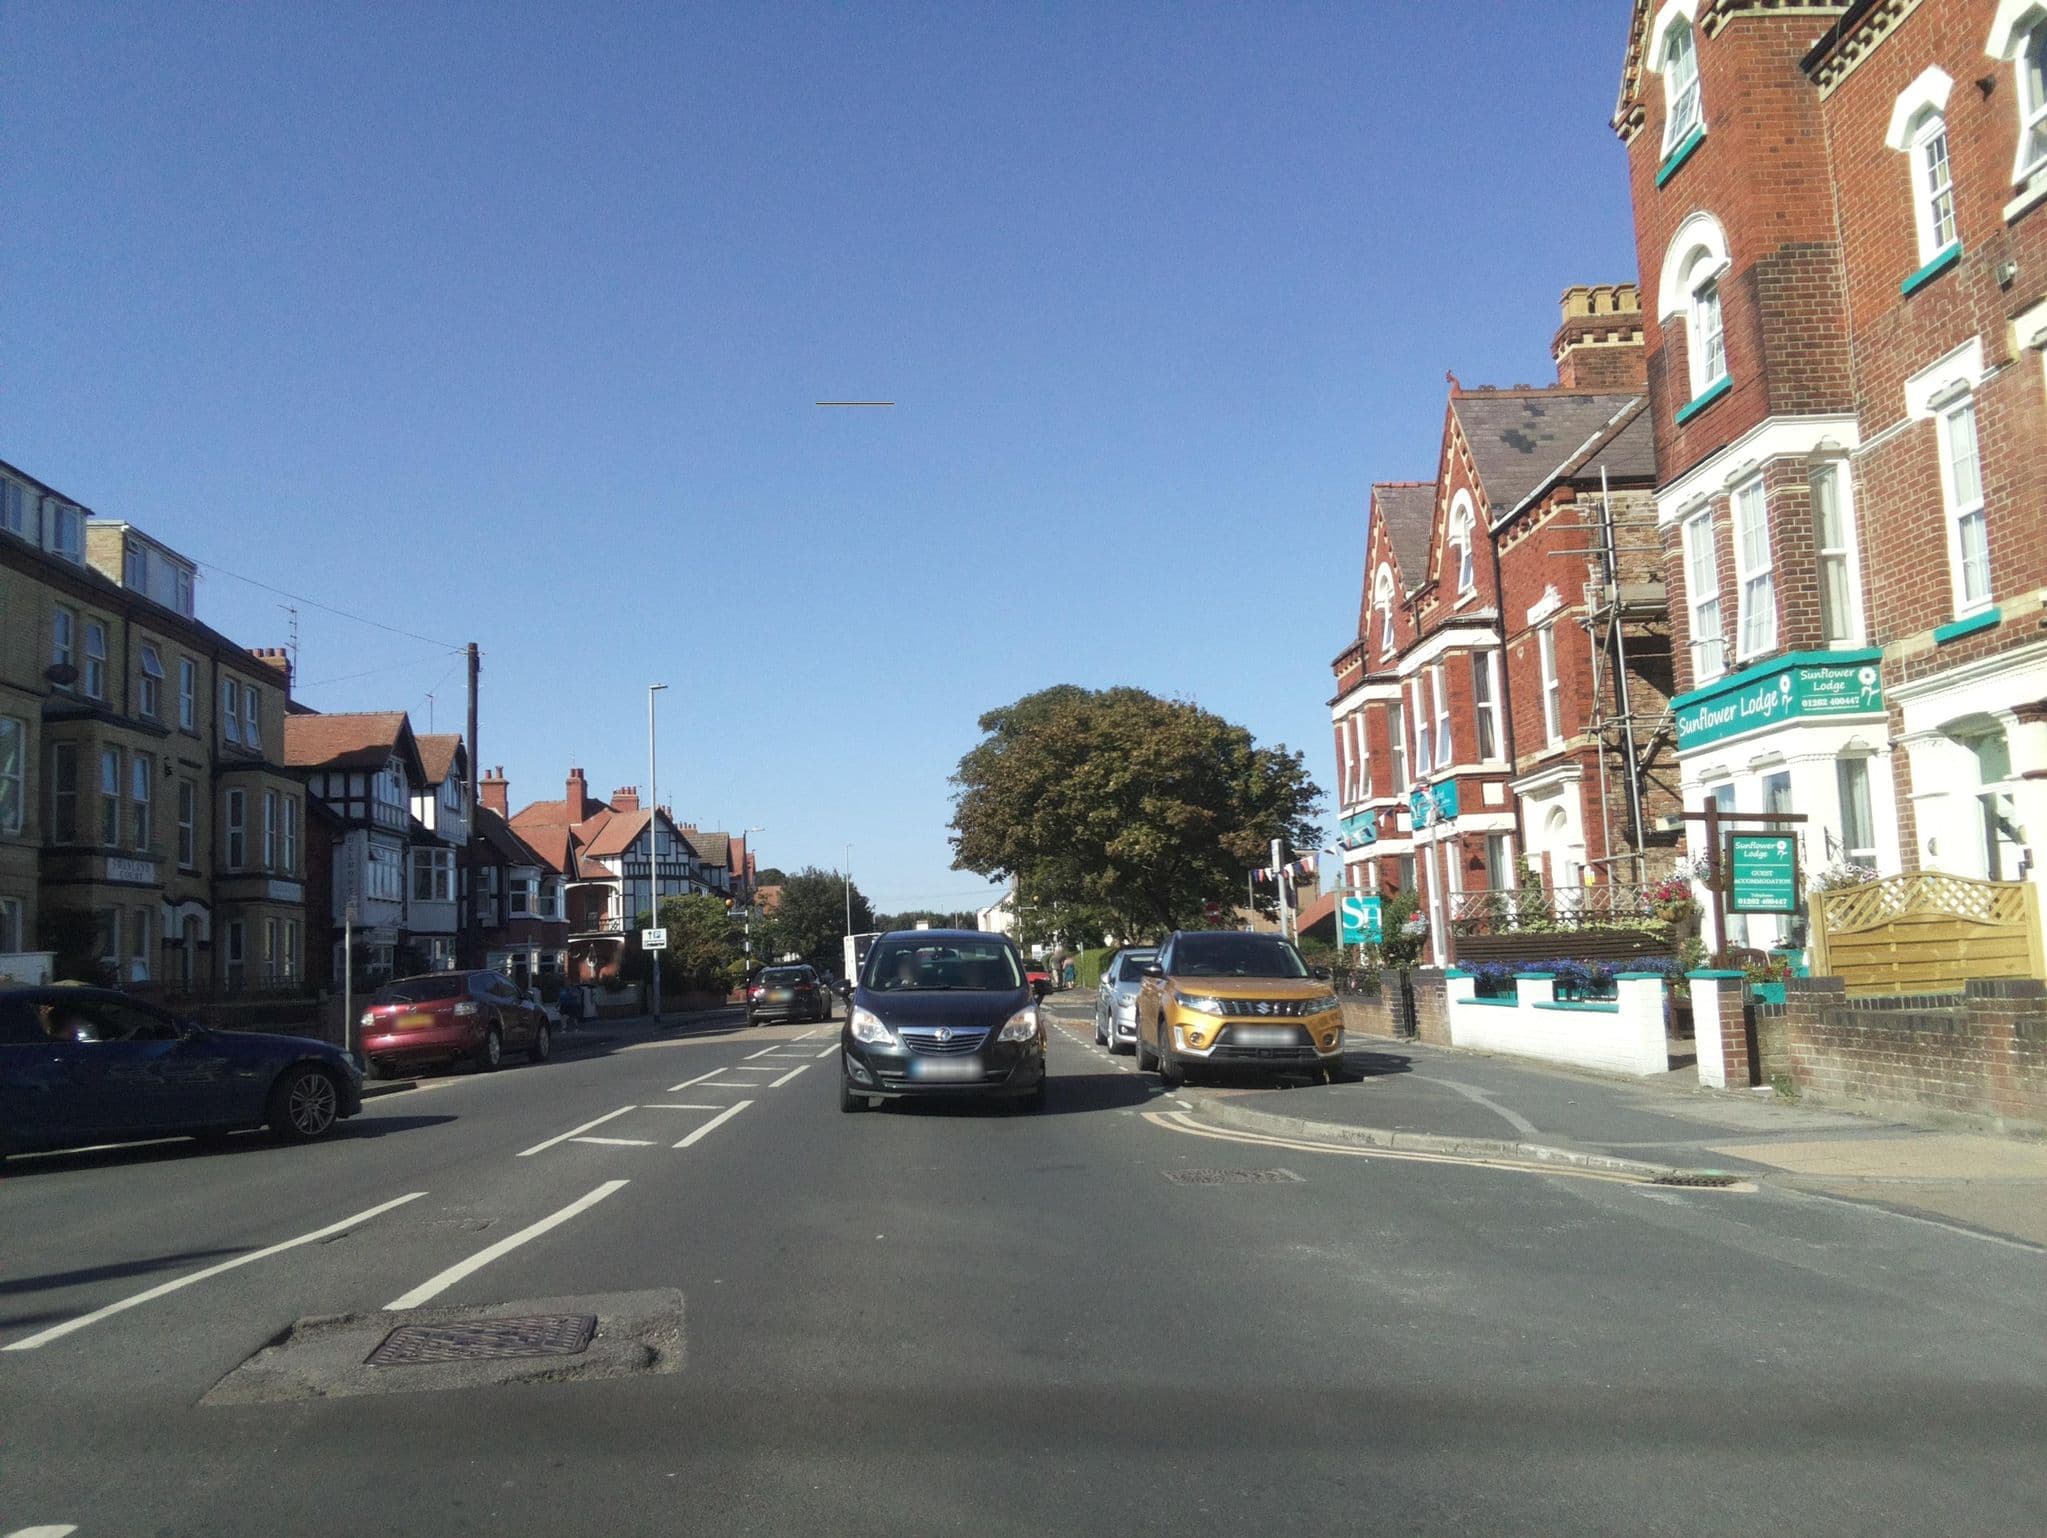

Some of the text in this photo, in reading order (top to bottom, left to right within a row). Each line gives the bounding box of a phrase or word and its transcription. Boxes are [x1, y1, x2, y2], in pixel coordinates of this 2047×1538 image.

[1800, 668, 1856, 680] Sunflower
[1813, 680, 1845, 693] Lodge
[1801, 698, 1828, 707] 01262
[1679, 687, 1779, 737] Sunflower Lodge
[1735, 841, 1777, 850] Sunflower
[1743, 850, 1768, 860] Lodge
